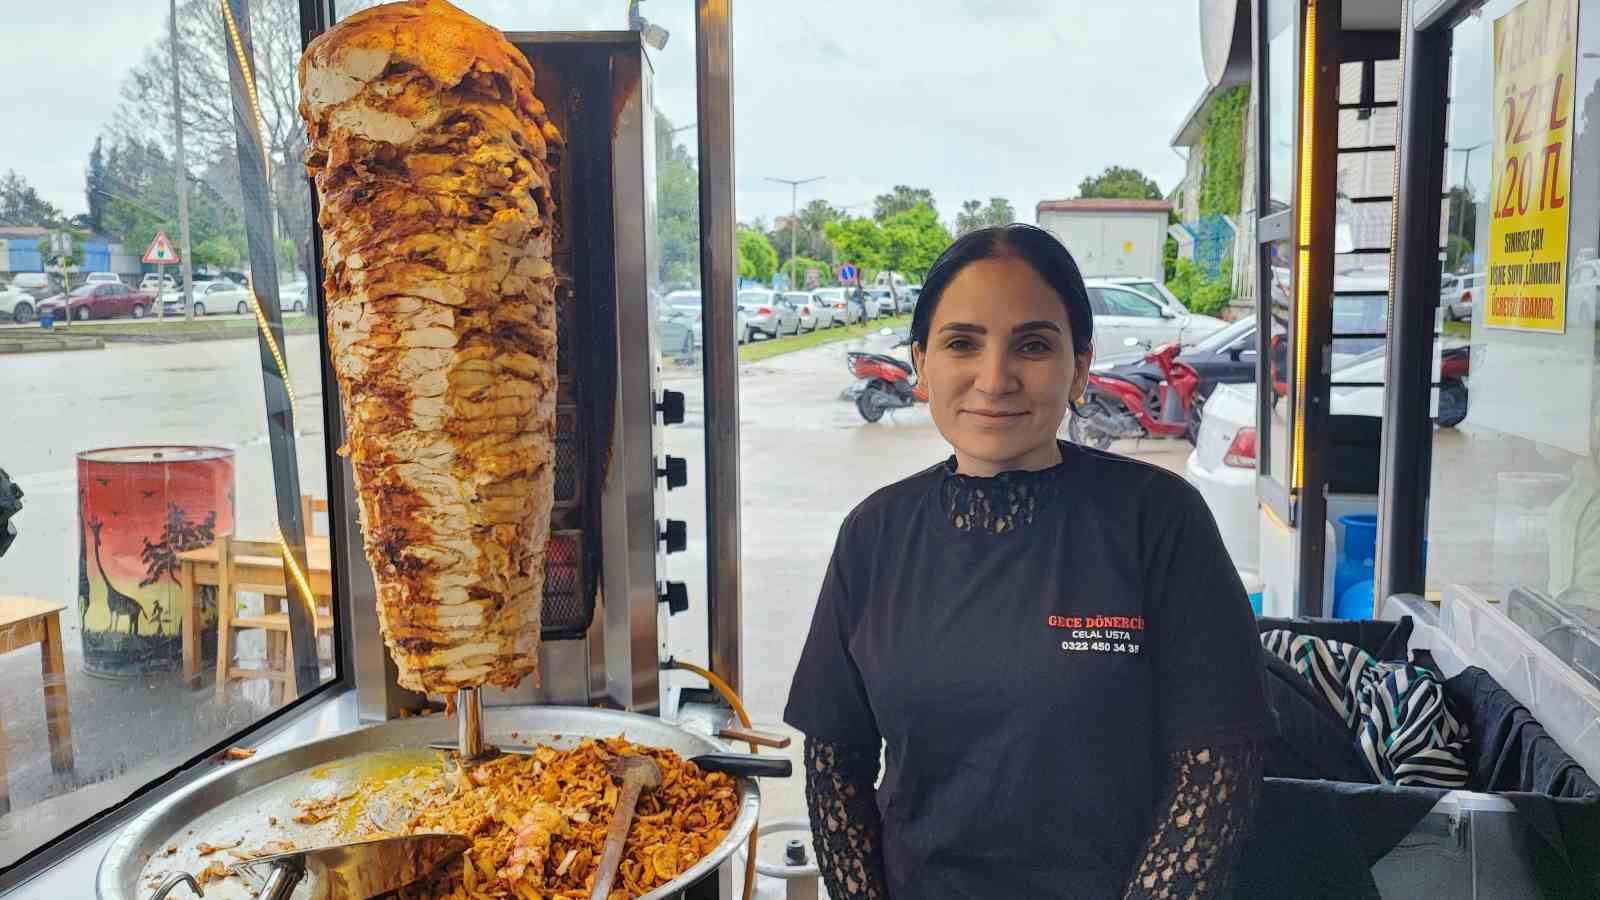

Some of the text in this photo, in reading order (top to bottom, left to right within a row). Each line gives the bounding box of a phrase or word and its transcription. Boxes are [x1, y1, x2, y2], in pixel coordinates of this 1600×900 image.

[1540, 142, 1565, 211] TL
[1531, 227, 1544, 258] ÇAY
[1048, 615, 1082, 628] GECE
[1072, 630, 1131, 640] CELAL USTA
[1061, 641, 1089, 651] 0322
[1091, 642, 1111, 652] 450
[1113, 643, 1126, 653] 34
